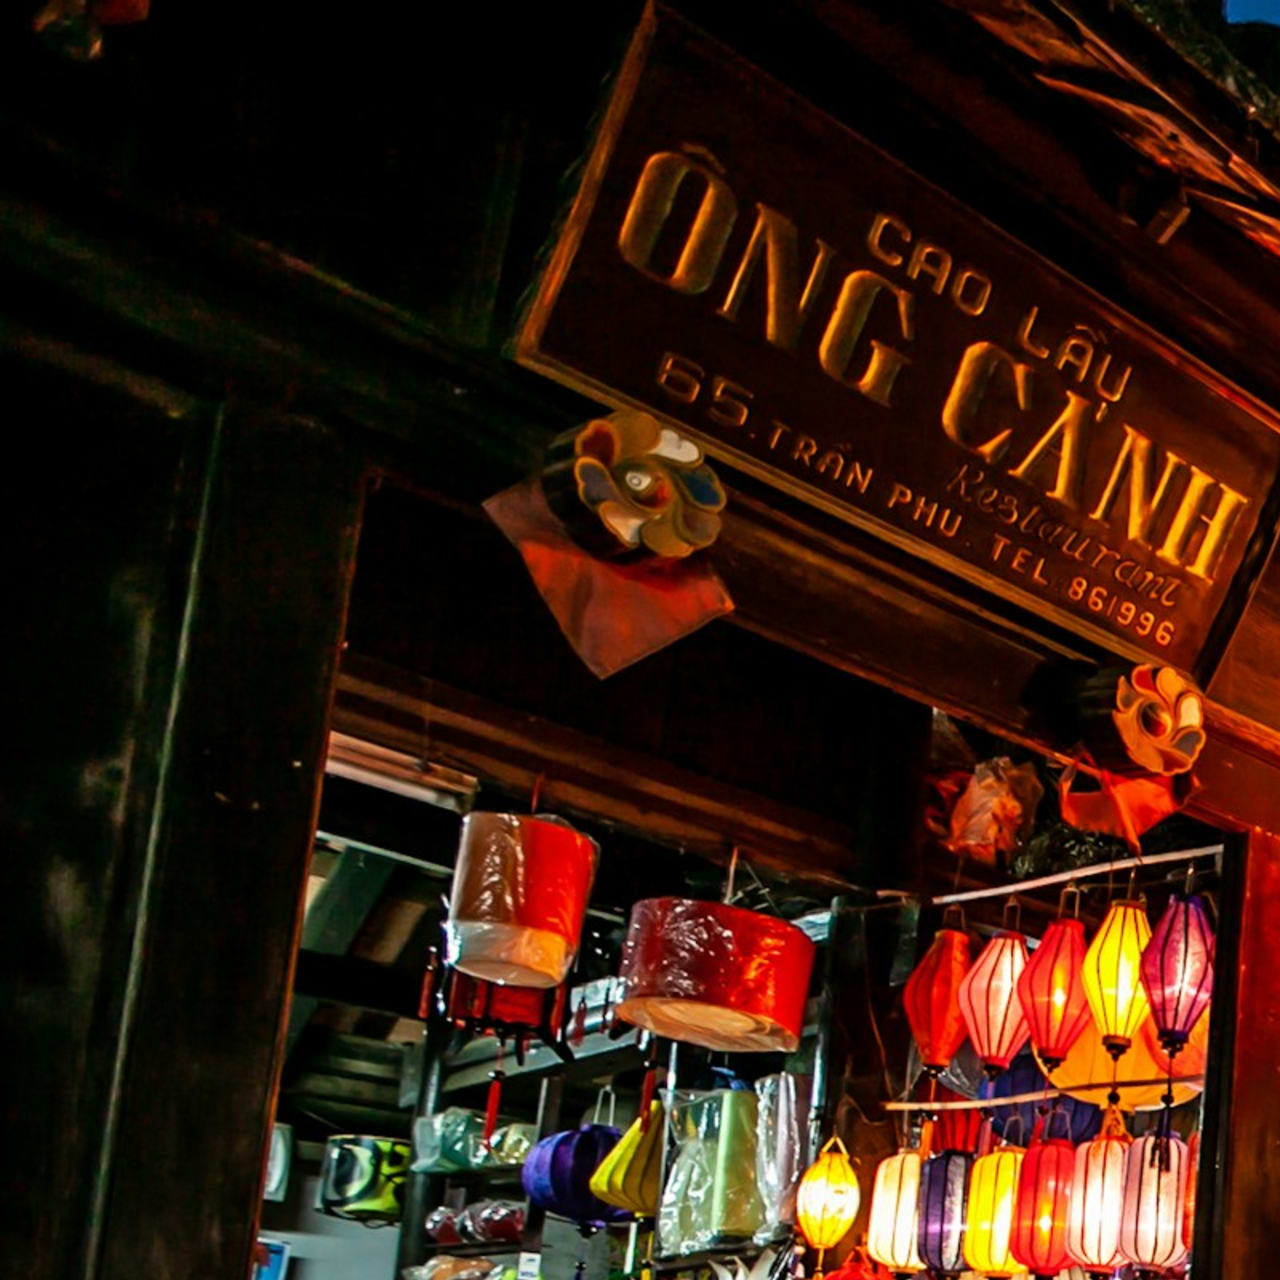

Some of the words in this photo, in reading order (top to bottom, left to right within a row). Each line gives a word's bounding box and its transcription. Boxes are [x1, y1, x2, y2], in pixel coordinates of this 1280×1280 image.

[618, 141, 915, 409] ÔNG
[866, 211, 993, 317] CAO
[947, 464, 1182, 607] Restaurant
[1067, 576, 1176, 647] 861996
